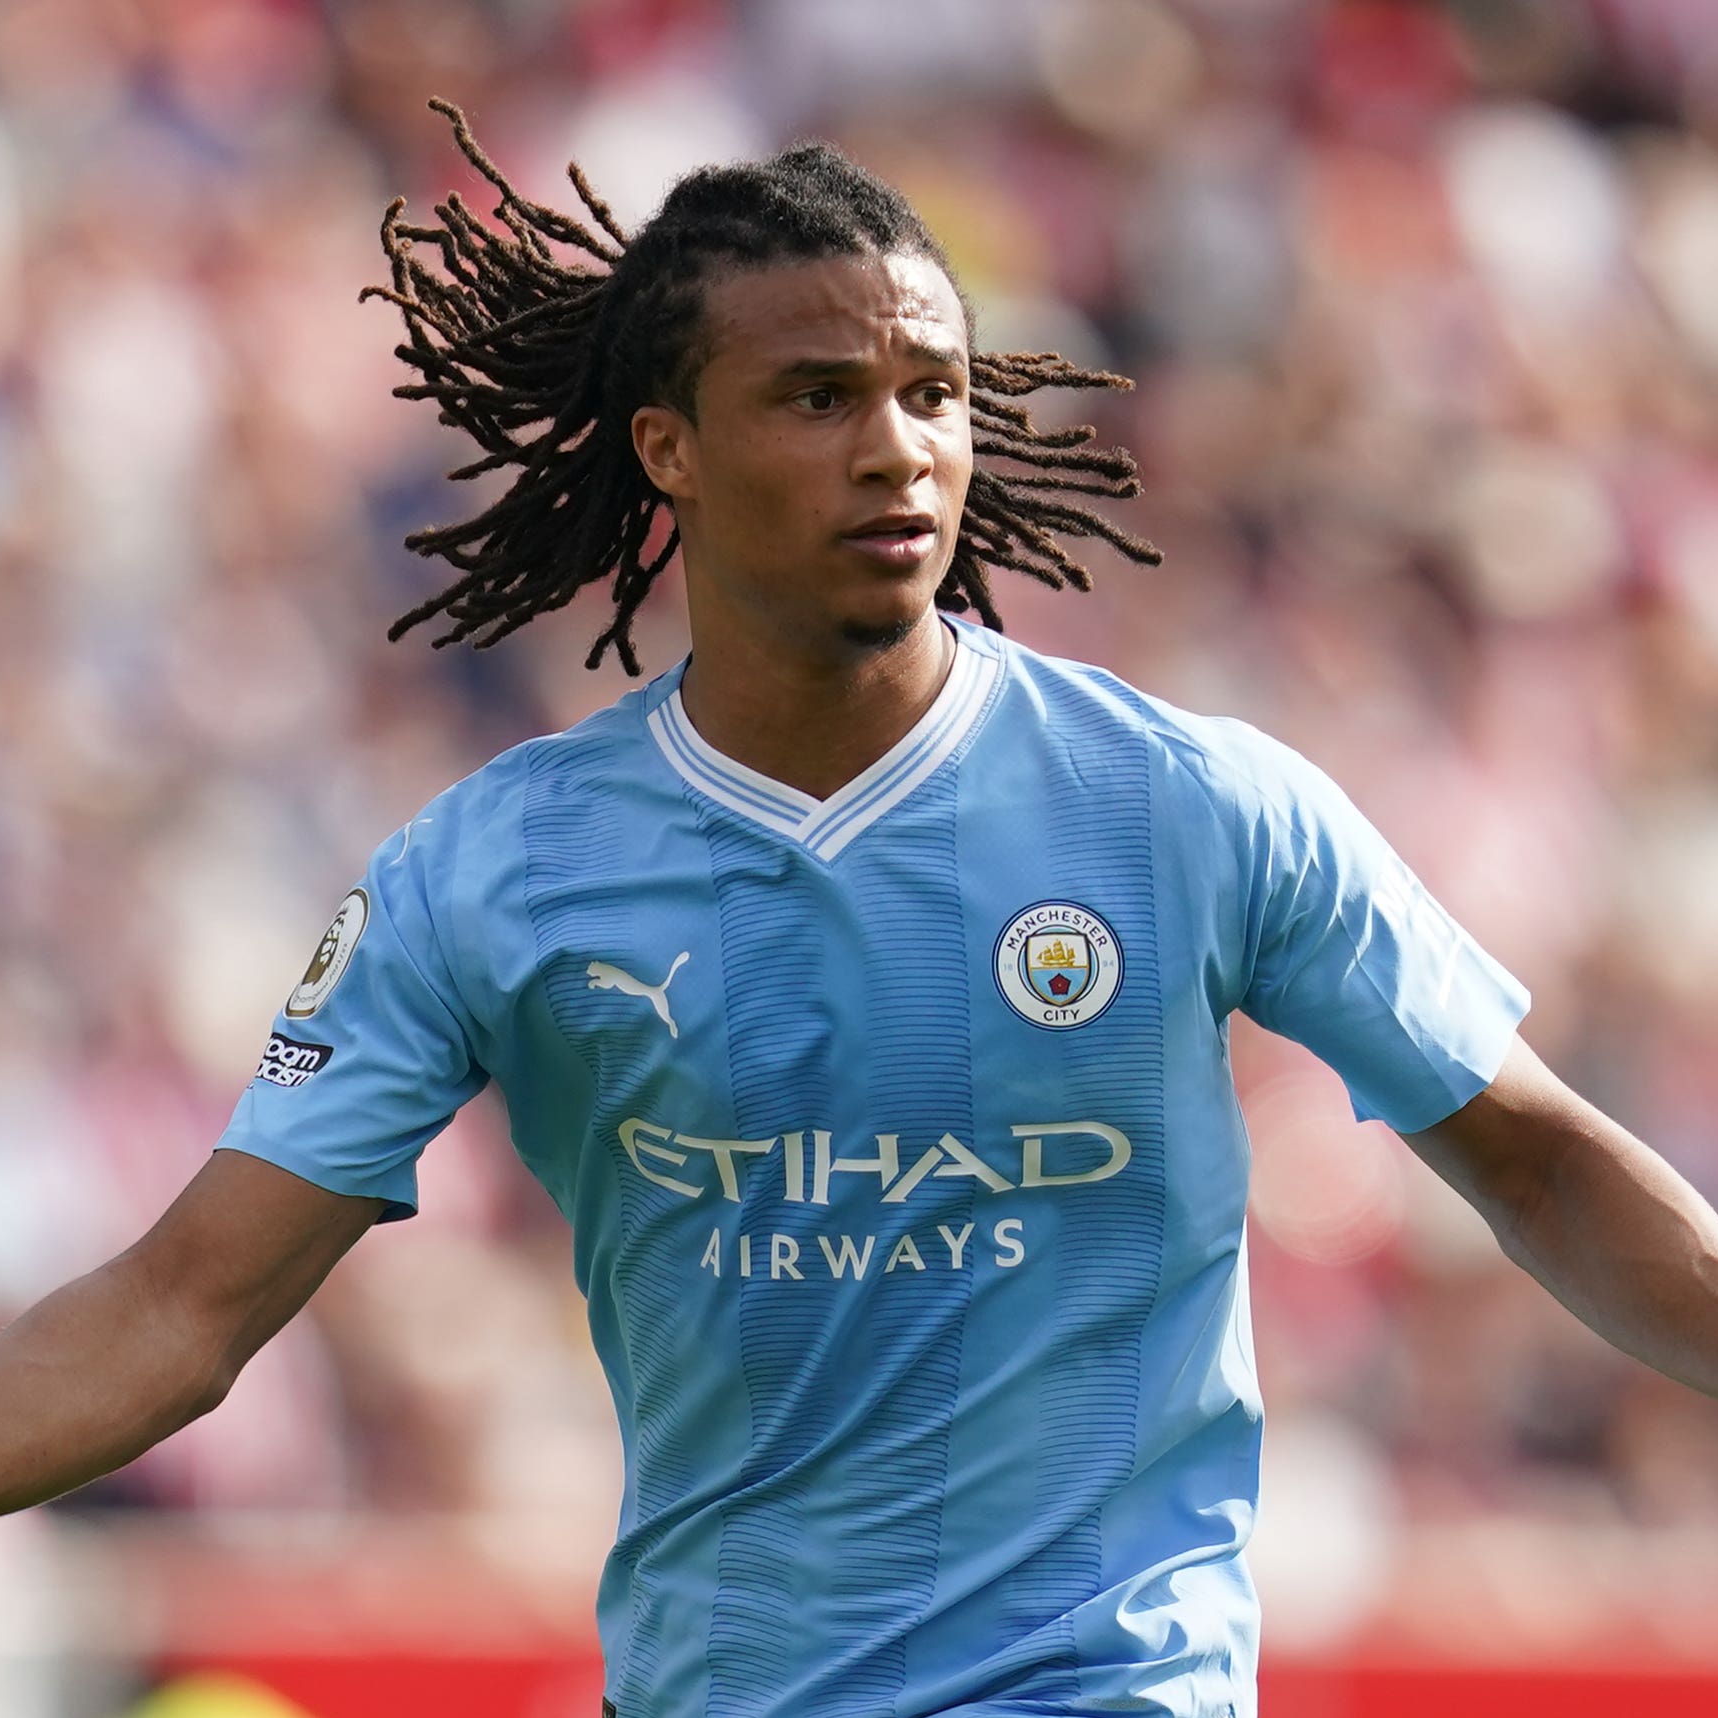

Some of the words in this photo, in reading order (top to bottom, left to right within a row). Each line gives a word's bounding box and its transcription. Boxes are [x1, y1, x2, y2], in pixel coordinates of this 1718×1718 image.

[1007, 910, 1108, 950] MANCHESTER
[1043, 1009, 1080, 1021] CITY
[618, 1117, 1131, 1204] ETIHAD
[701, 1218, 1024, 1280] AIRWAYS
